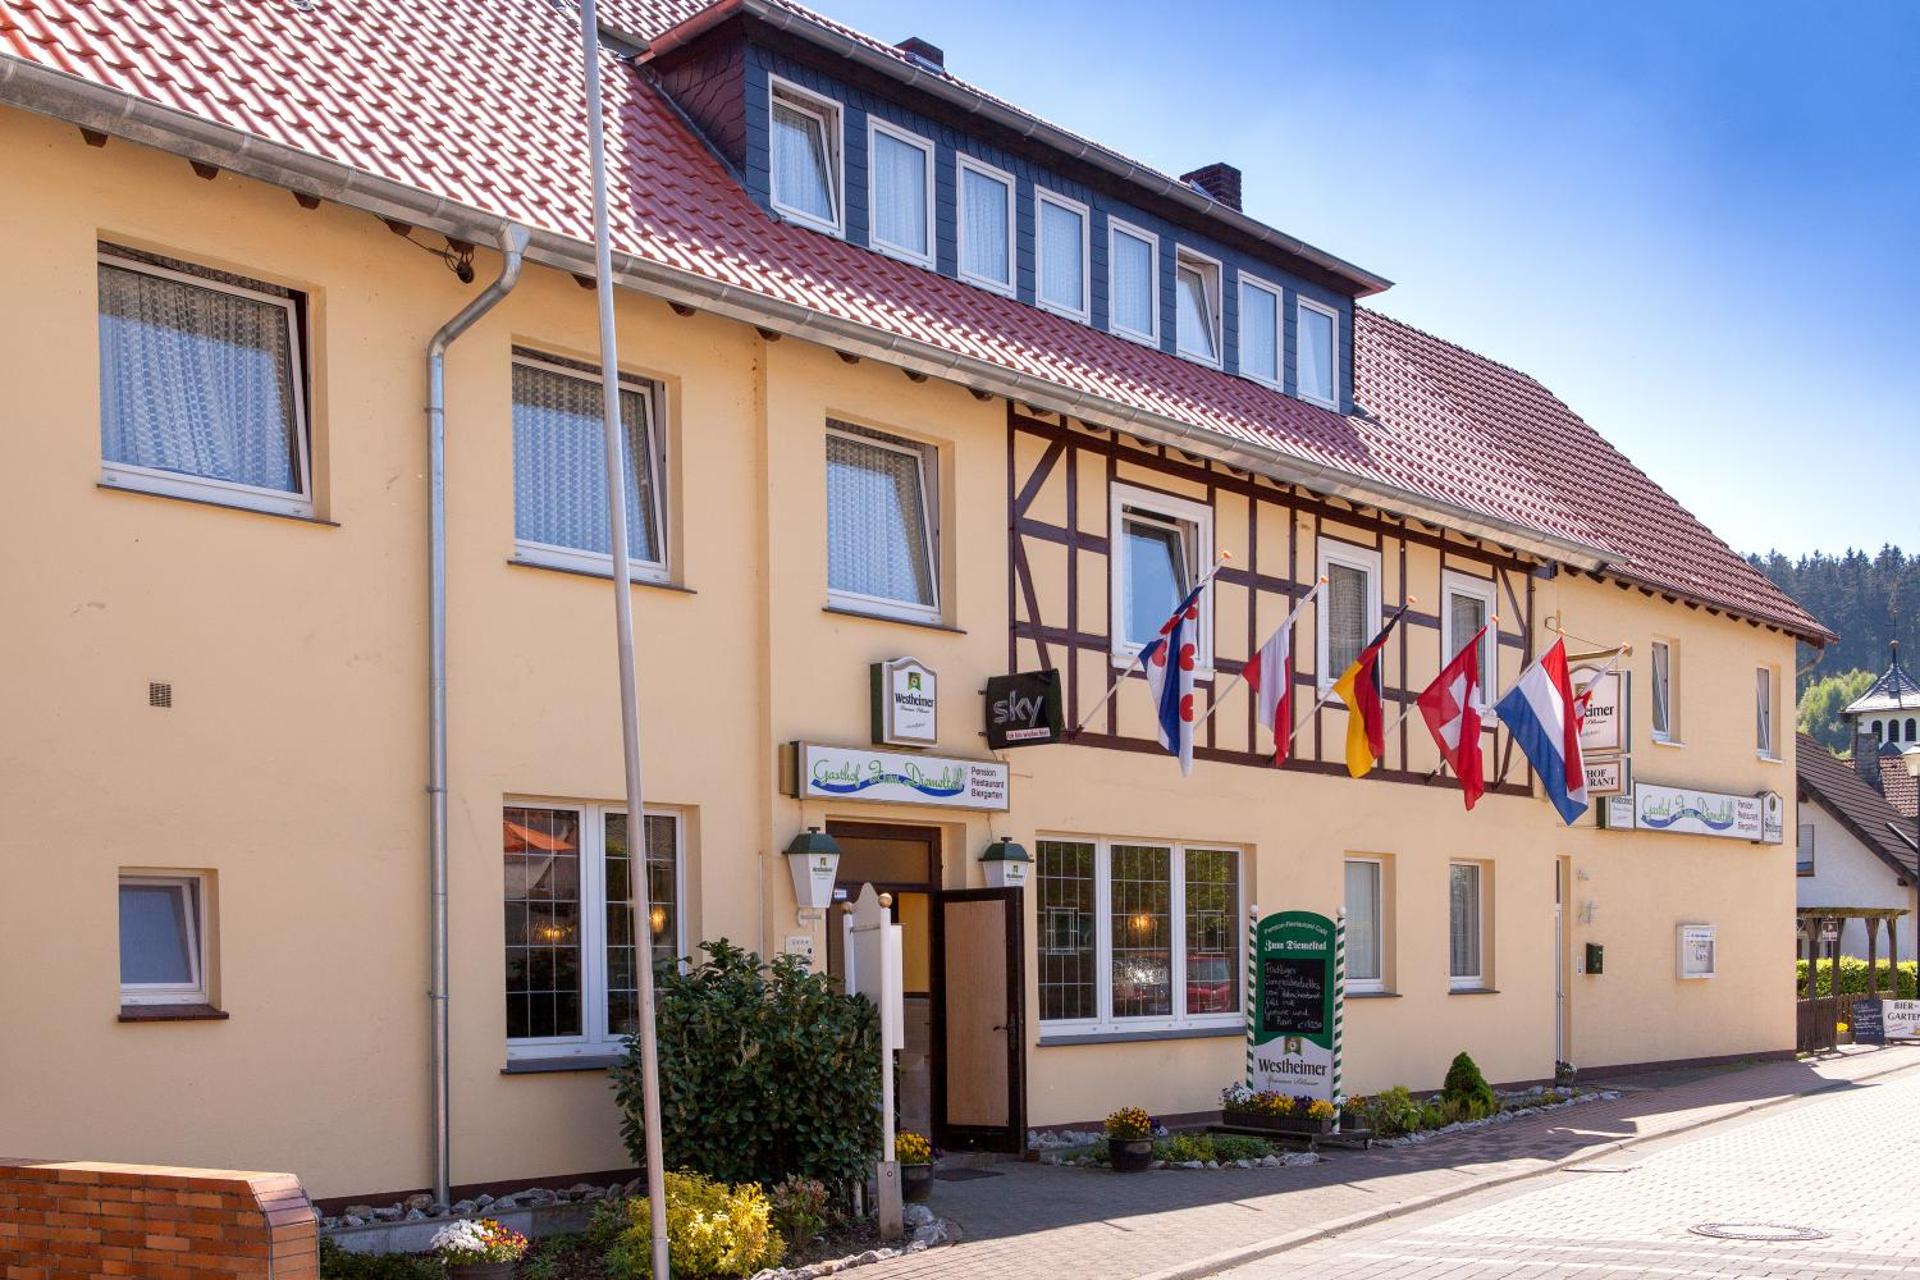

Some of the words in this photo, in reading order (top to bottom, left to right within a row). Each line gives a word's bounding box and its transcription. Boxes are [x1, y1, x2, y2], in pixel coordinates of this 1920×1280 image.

[895, 692, 934, 707] Westheimer
[993, 690, 1043, 728] sky
[1585, 704, 1615, 717] eimer
[813, 759, 861, 788] Gasthof
[971, 766, 997, 777] Pension
[1586, 769, 1607, 778] HOF
[971, 778, 1004, 788] Restaurant
[1589, 777, 1615, 787] RANT
[971, 788, 1003, 800] Biergarten
[1264, 939, 1285, 952] Zum
[1286, 940, 1328, 951] Diemeltal
[1894, 1002, 1919, 1010] BIER-
[1258, 1058, 1328, 1076] Westheimer
